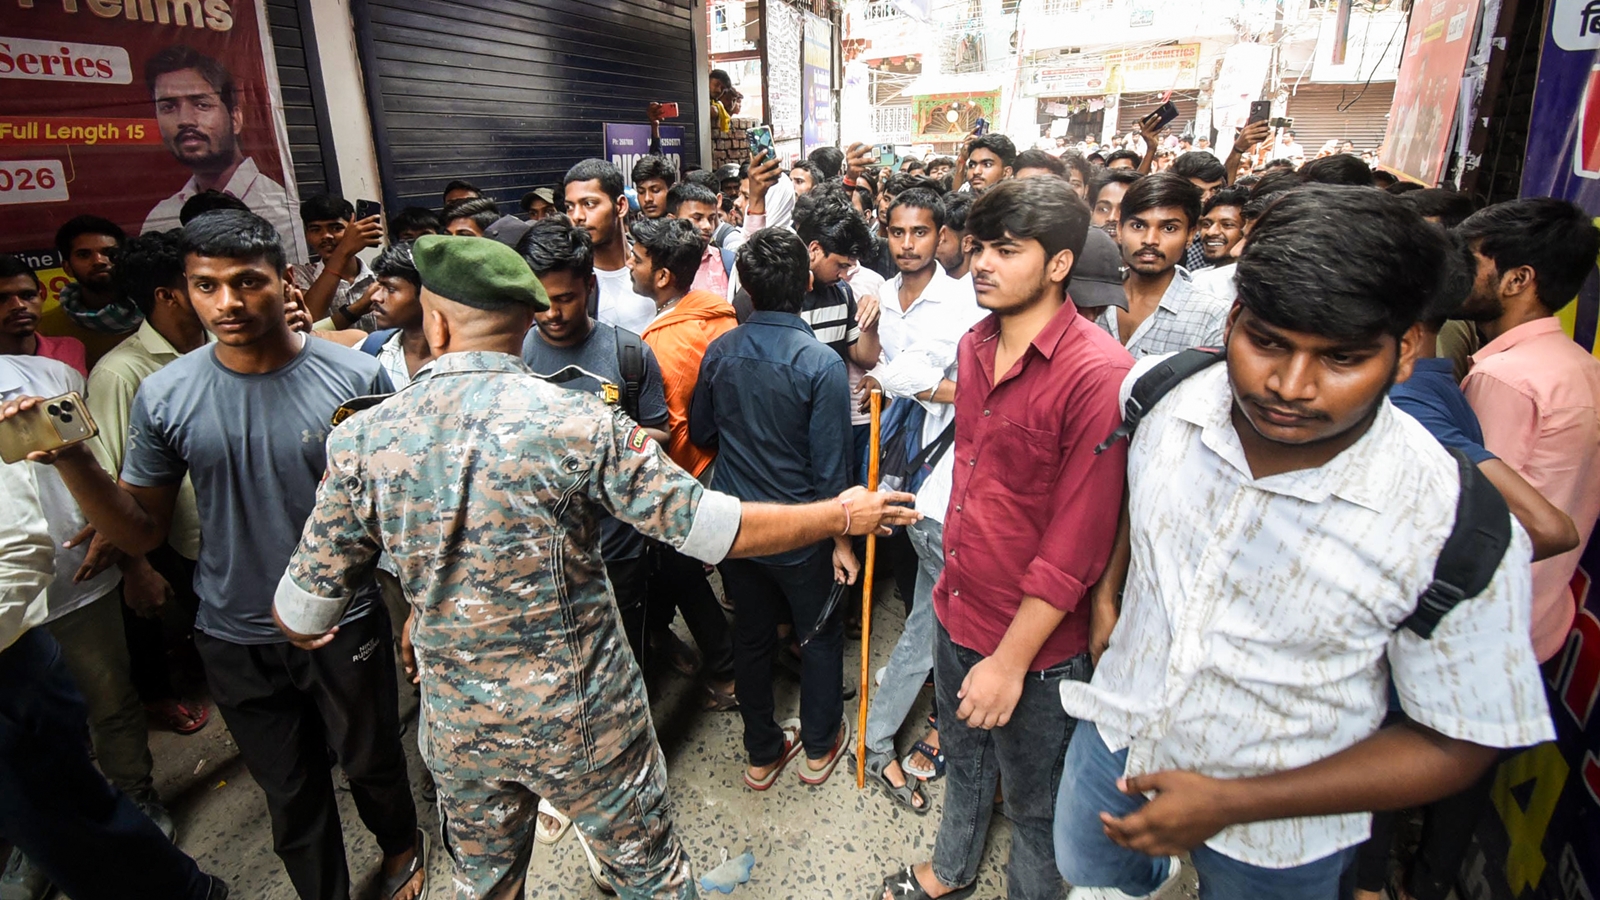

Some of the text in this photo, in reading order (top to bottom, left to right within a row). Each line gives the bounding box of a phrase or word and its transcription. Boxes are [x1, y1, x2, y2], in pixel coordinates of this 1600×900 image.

[19, 0, 234, 32] elims
[0, 43, 114, 79] Series
[0, 122, 145, 145] Full Length 15
